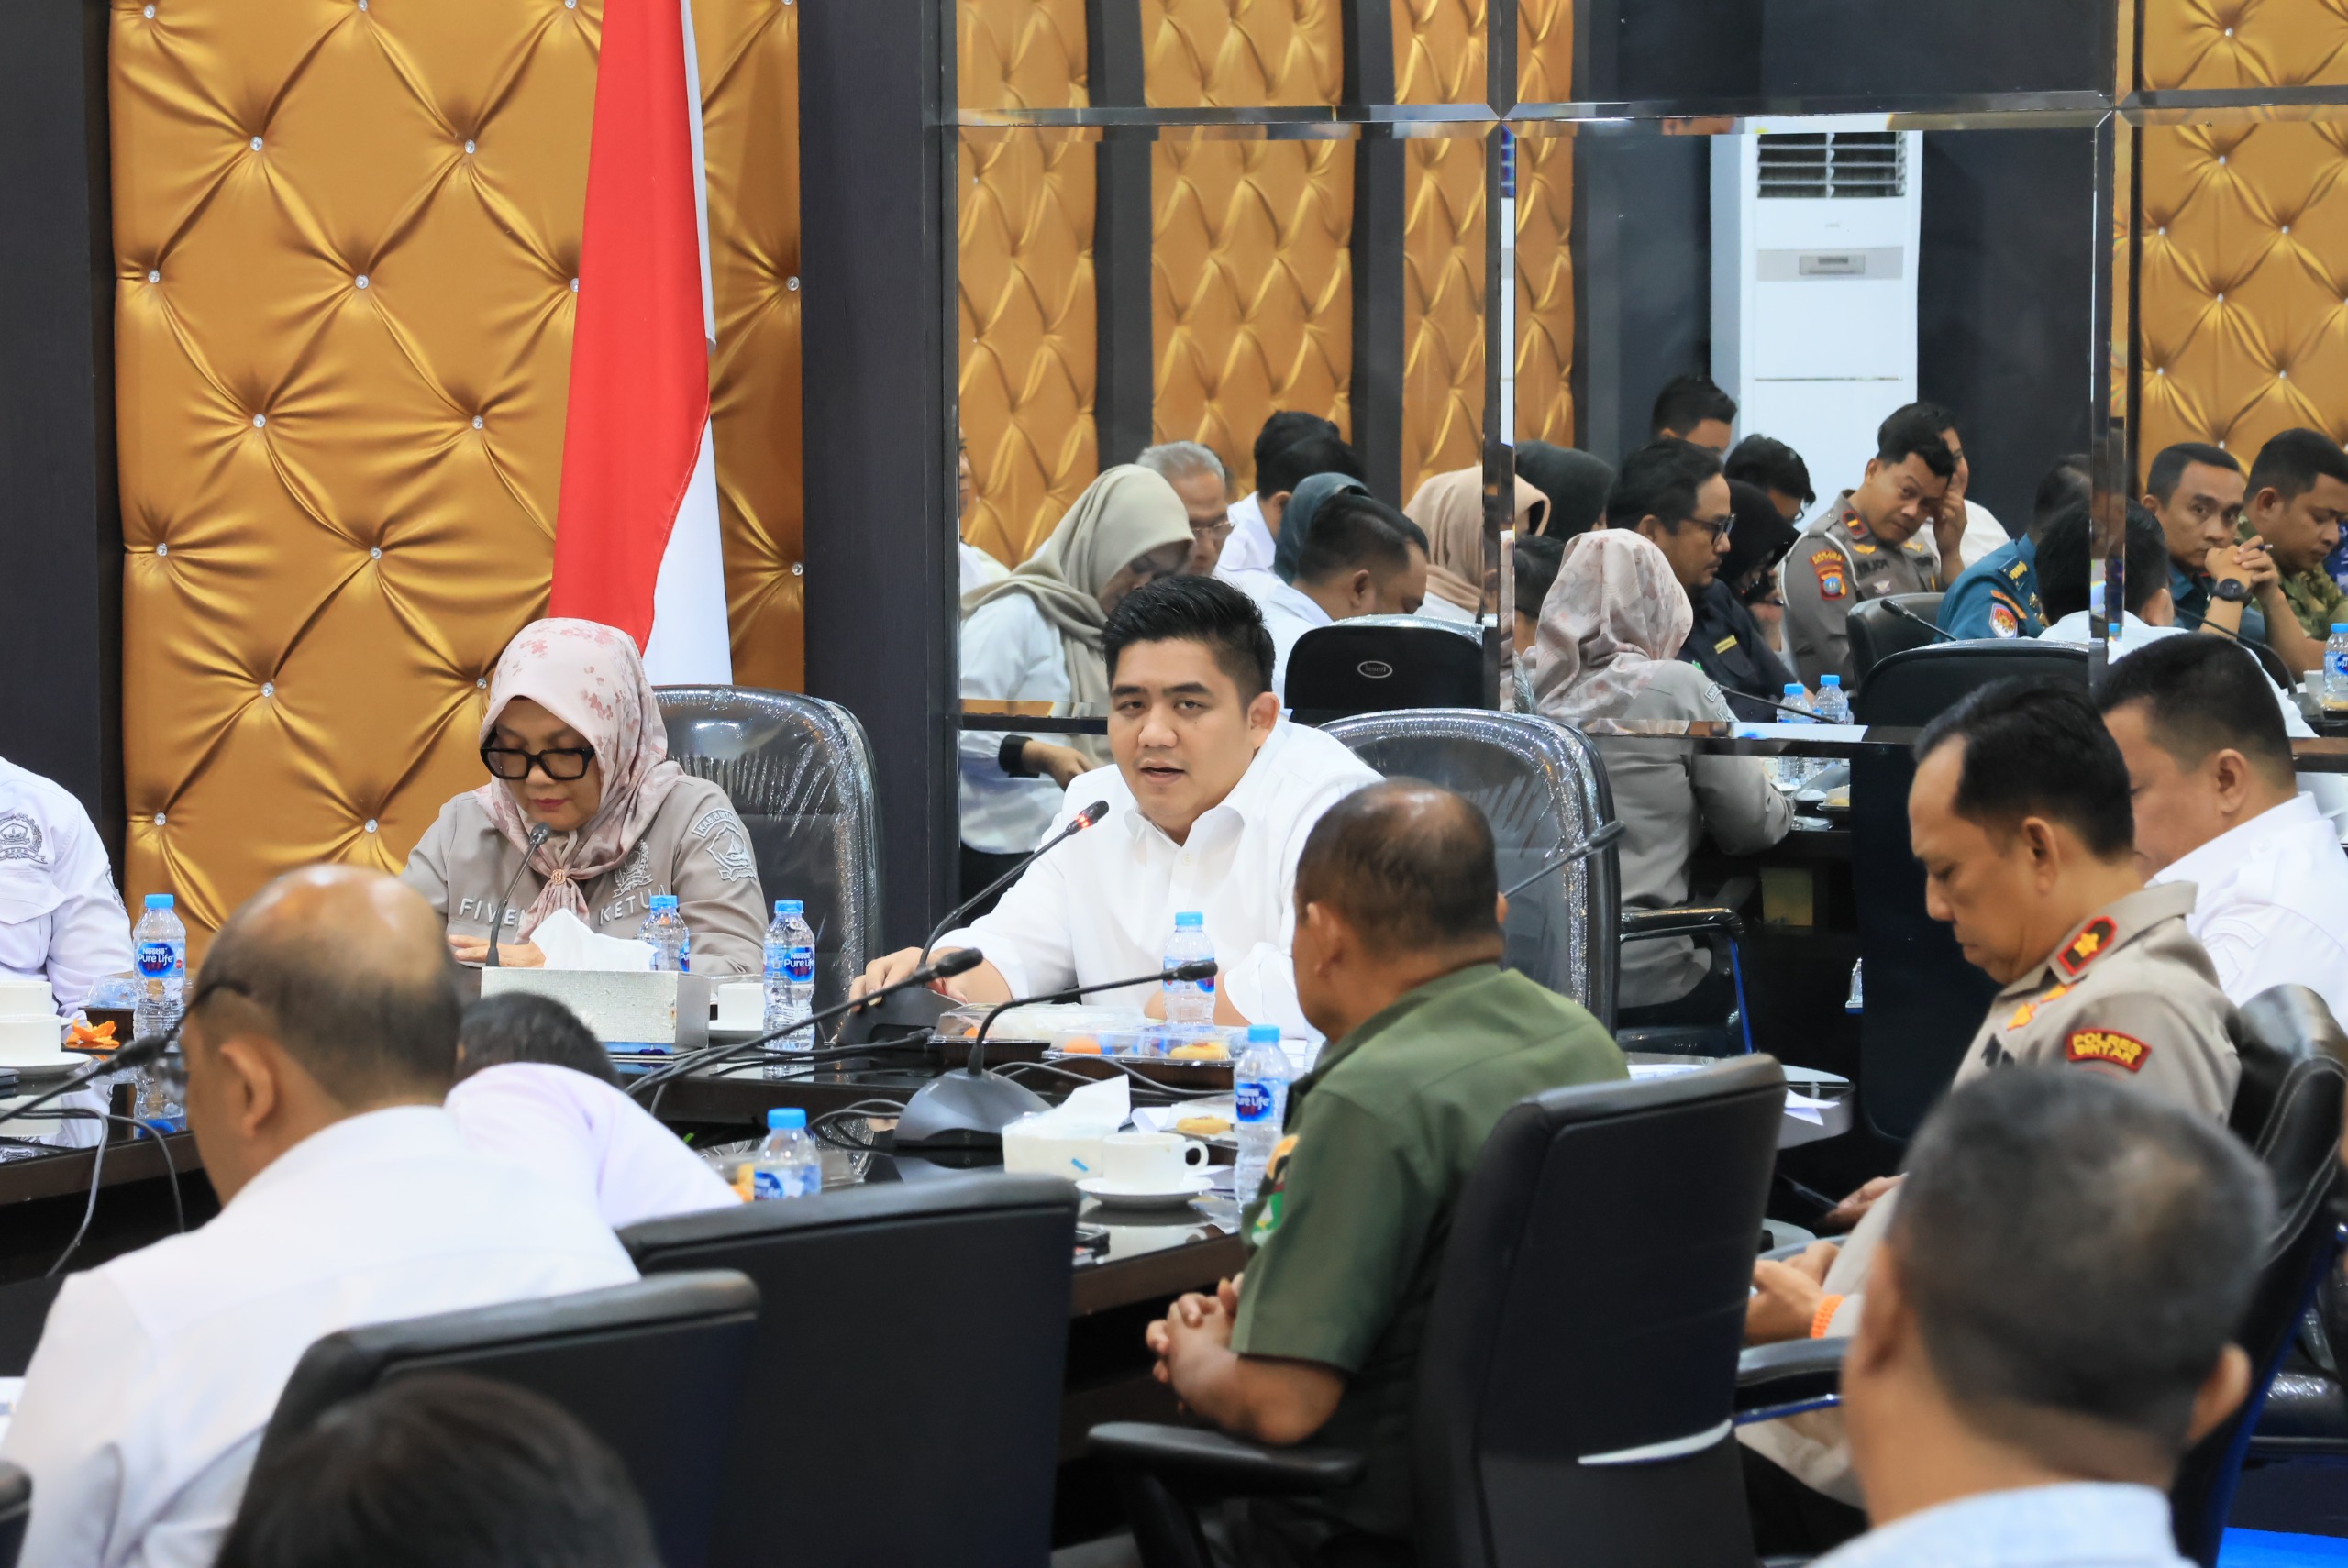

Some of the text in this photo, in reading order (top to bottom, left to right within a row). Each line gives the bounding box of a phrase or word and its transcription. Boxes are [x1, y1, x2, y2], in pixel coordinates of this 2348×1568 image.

[138, 954, 173, 966] Pure Life
[784, 959, 804, 967] Pure
